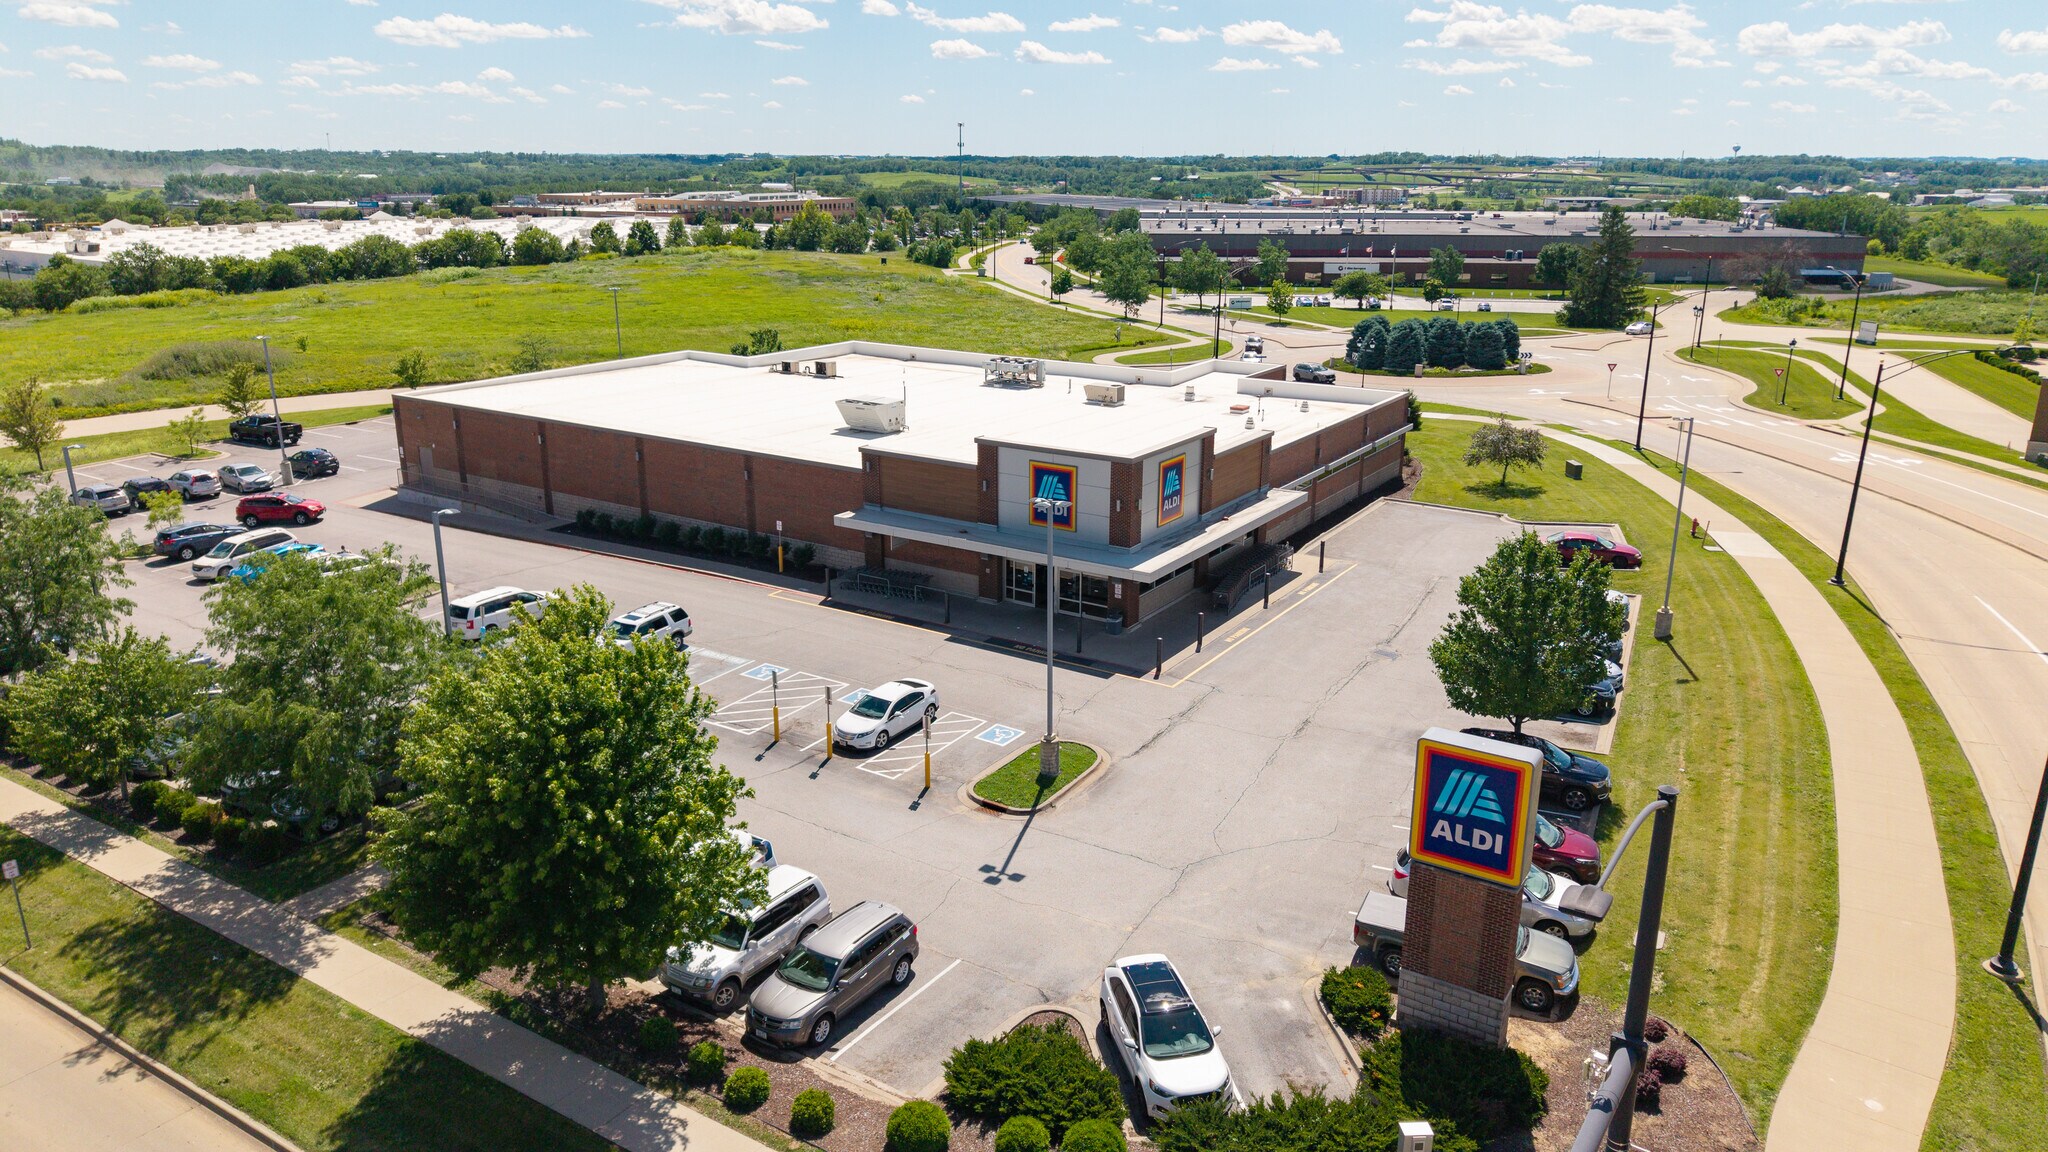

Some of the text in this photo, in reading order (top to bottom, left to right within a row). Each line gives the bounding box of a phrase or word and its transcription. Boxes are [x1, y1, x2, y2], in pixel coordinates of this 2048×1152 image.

[1037, 503, 1067, 516] ADI
[1163, 495, 1180, 511] ALDI
[1431, 819, 1503, 855] ALDI
